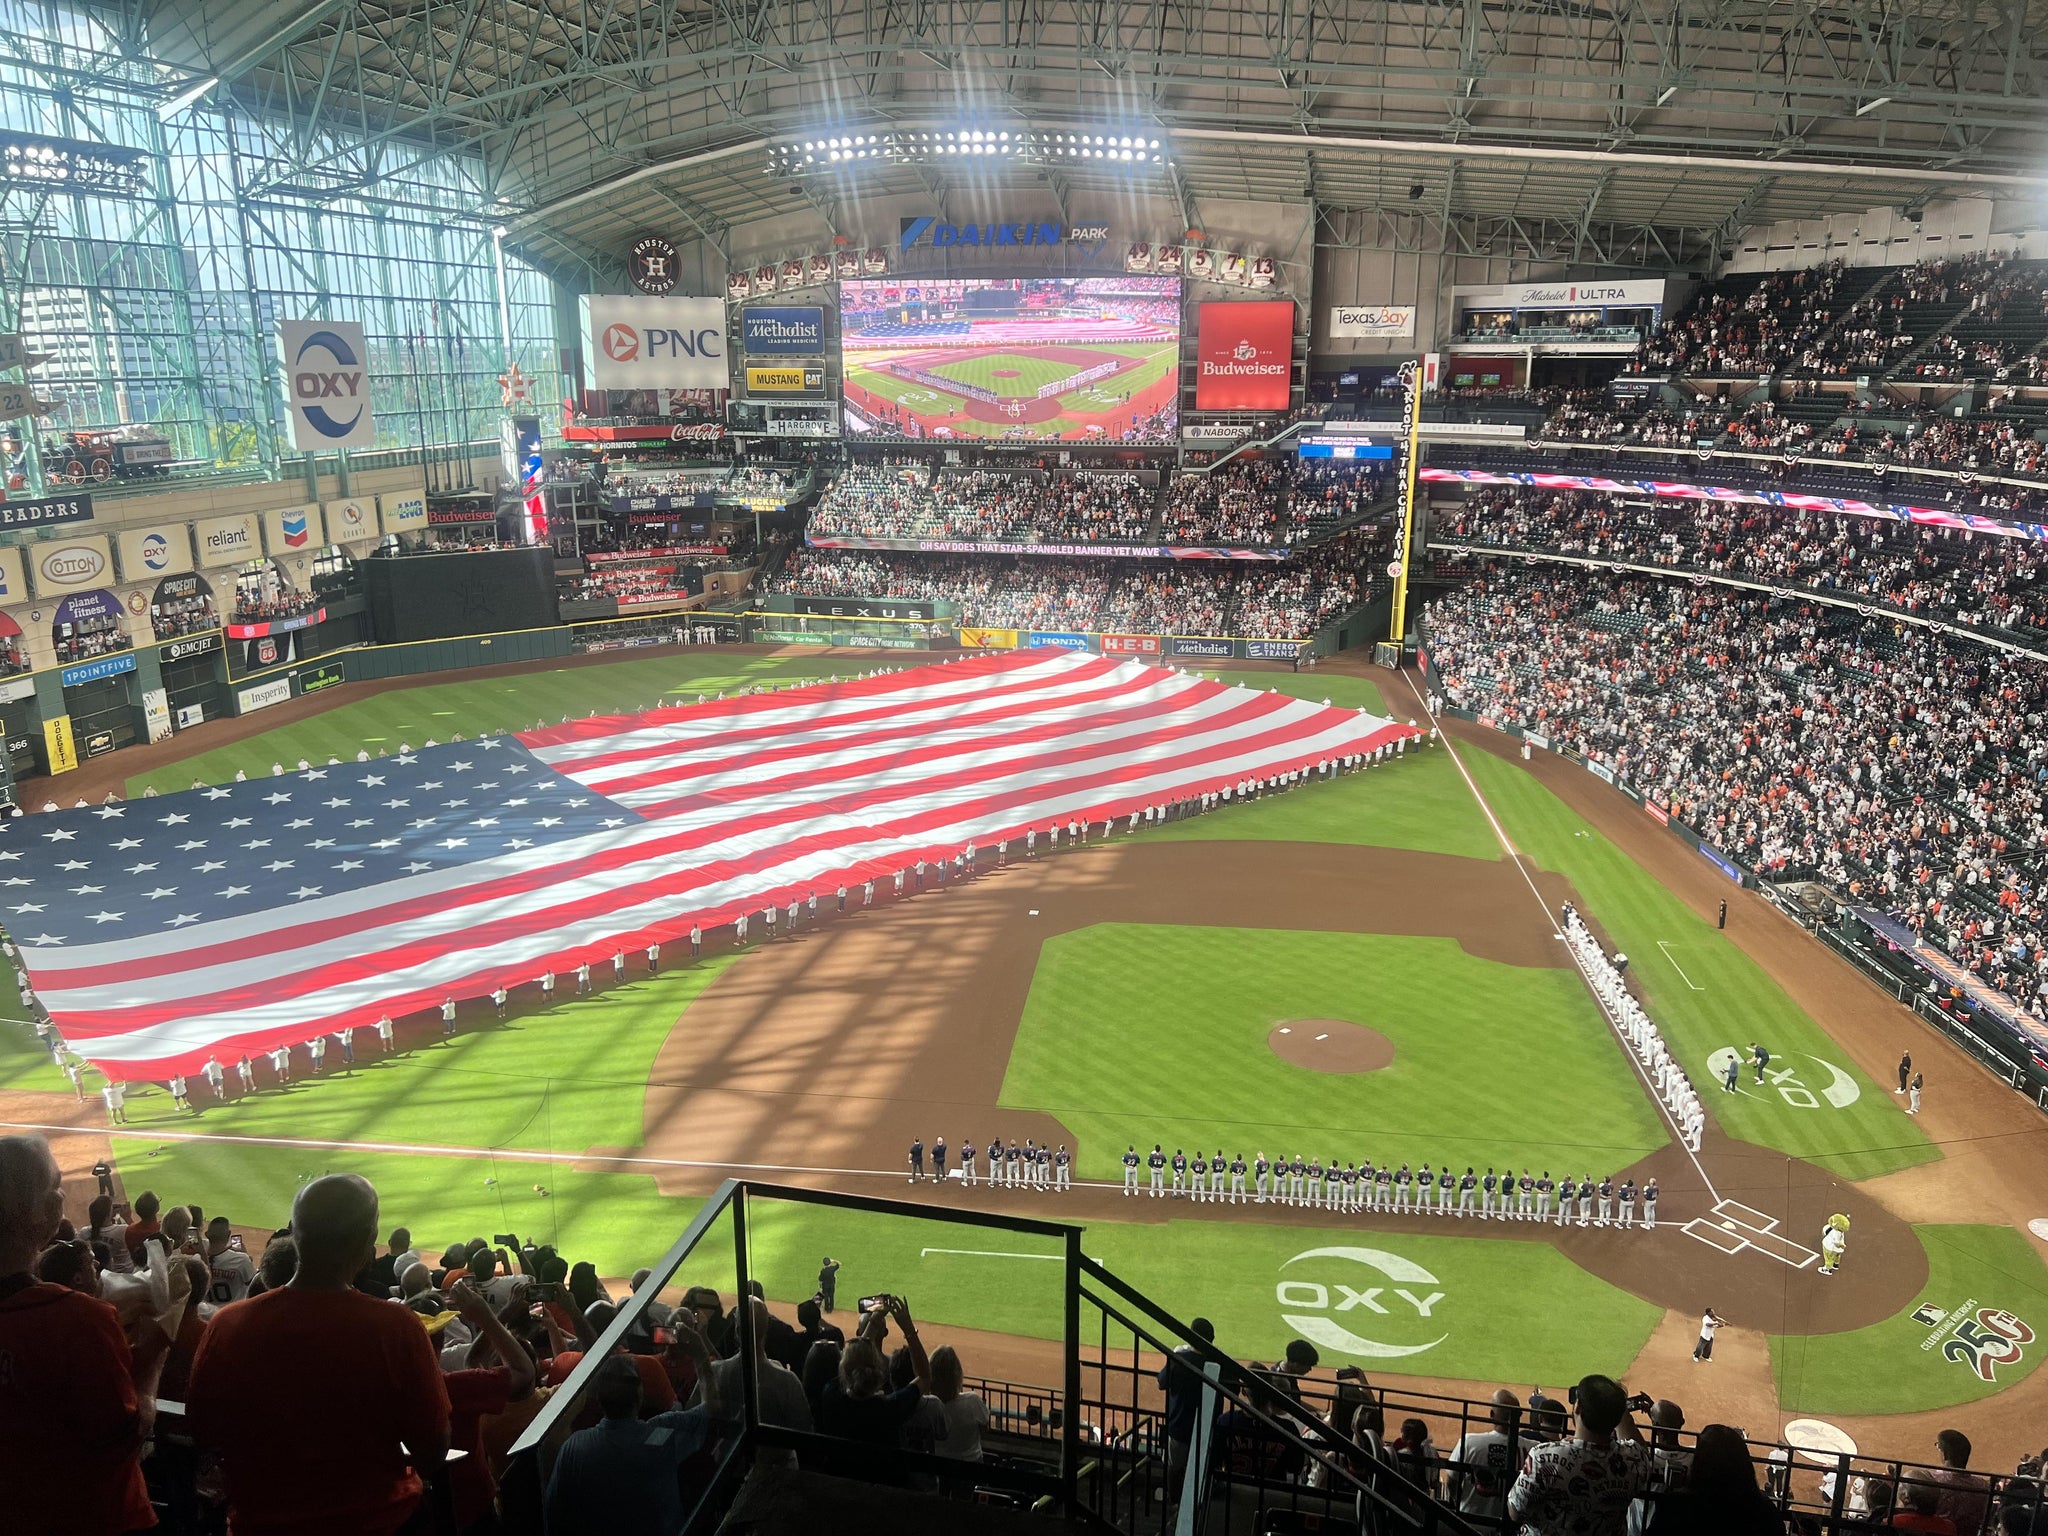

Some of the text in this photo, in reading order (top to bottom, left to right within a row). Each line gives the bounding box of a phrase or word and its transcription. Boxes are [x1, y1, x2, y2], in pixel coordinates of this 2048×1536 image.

[932, 222, 1109, 247] DAIKIN PARK
[634, 239, 674, 256] HOUSTON
[1128, 243, 1148, 259] 49
[1158, 247, 1180, 262] 24
[646, 256, 666, 276] H
[810, 255, 828, 271] 33
[1195, 250, 1206, 266] 5
[1227, 255, 1238, 270] 7
[1254, 258, 1273, 274] 13
[755, 265, 774, 281] 40
[782, 260, 801, 276] 25
[638, 278, 674, 292] ASTROS
[729, 272, 748, 288] 32
[1521, 288, 1626, 303] Michelob ULTRA
[1337, 309, 1409, 328] Texas Bay
[749, 321, 817, 337] Methodist
[643, 328, 720, 358] PNC
[296, 372, 361, 398] OXY
[756, 374, 822, 385] MUSTANG CAT
[3, 394, 24, 410] 22
[1401, 392, 1414, 436] ROOT
[779, 421, 830, 433] HARGROVE
[1203, 428, 1244, 437] NABORS
[600, 441, 637, 450] HORNITOS
[739, 497, 787, 506] PLUCKERS
[0, 502, 80, 524] EADERS
[281, 510, 305, 518] Chevron
[429, 510, 494, 523] Budweiser
[629, 512, 681, 523] Budweiser
[1393, 496, 1407, 560] CHIKIN
[207, 528, 247, 548] reliant
[144, 546, 168, 559] OXY
[611, 551, 652, 560] Budweiser
[674, 546, 714, 555] Budweiser
[920, 541, 1160, 557] OH SAY DOES THAT STAR-SPANGLED BANNER YET WAVE
[50, 556, 98, 577] COTTON
[616, 568, 657, 578] Budweiser
[164, 582, 183, 595] SPACE
[183, 578, 197, 591] CITY
[68, 594, 100, 612] planet
[638, 592, 679, 602] Budweiser
[73, 604, 106, 618] fitness
[807, 606, 922, 619] LEXUS
[181, 638, 212, 656] EMCJET
[850, 636, 868, 647] SPACE
[868, 636, 881, 648] CITY
[1042, 637, 1086, 647] HONDA
[1177, 643, 1228, 655] Methodist
[1264, 642, 1299, 650] ENERGY
[262, 647, 275, 659] 66
[67, 659, 132, 681] 1POINTFIVE
[251, 684, 289, 704] Insperity
[147, 706, 165, 717] WM
[9, 740, 28, 752] 366
[53, 721, 66, 765] DOGGETT
[1276, 1281, 1445, 1317] OXY
[1920, 1298, 1978, 1351] CELEBRATING AMERICA'S
[1942, 1308, 2036, 1382] 250
